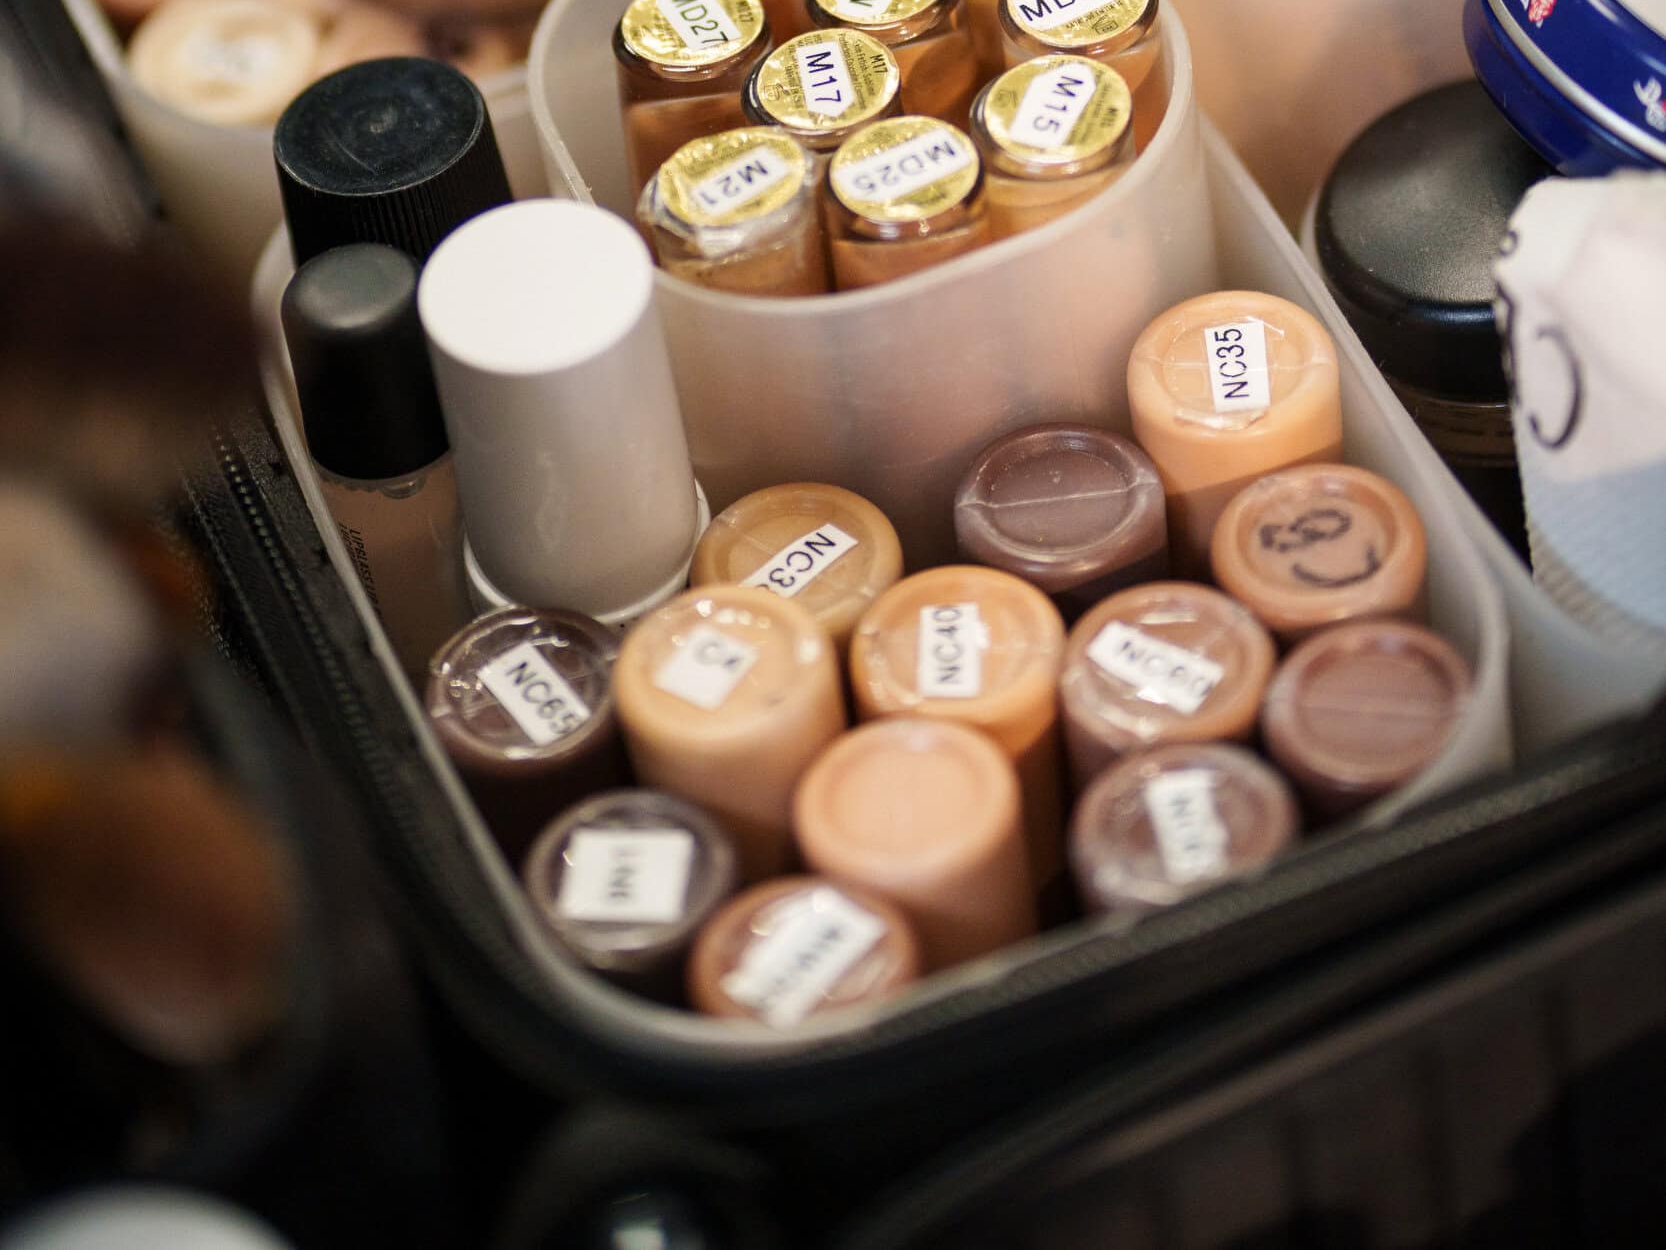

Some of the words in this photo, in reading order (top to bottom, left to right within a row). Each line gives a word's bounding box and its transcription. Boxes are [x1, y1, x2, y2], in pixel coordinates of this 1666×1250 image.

[804, 50, 842, 104] M17
[869, 53, 889, 74] M17
[1033, 75, 1085, 134] M15
[699, 159, 769, 205] M21
[852, 140, 956, 195] MD25
[1214, 327, 1250, 399] NC35
[754, 531, 836, 591] NC3
[938, 605, 961, 684] NC40
